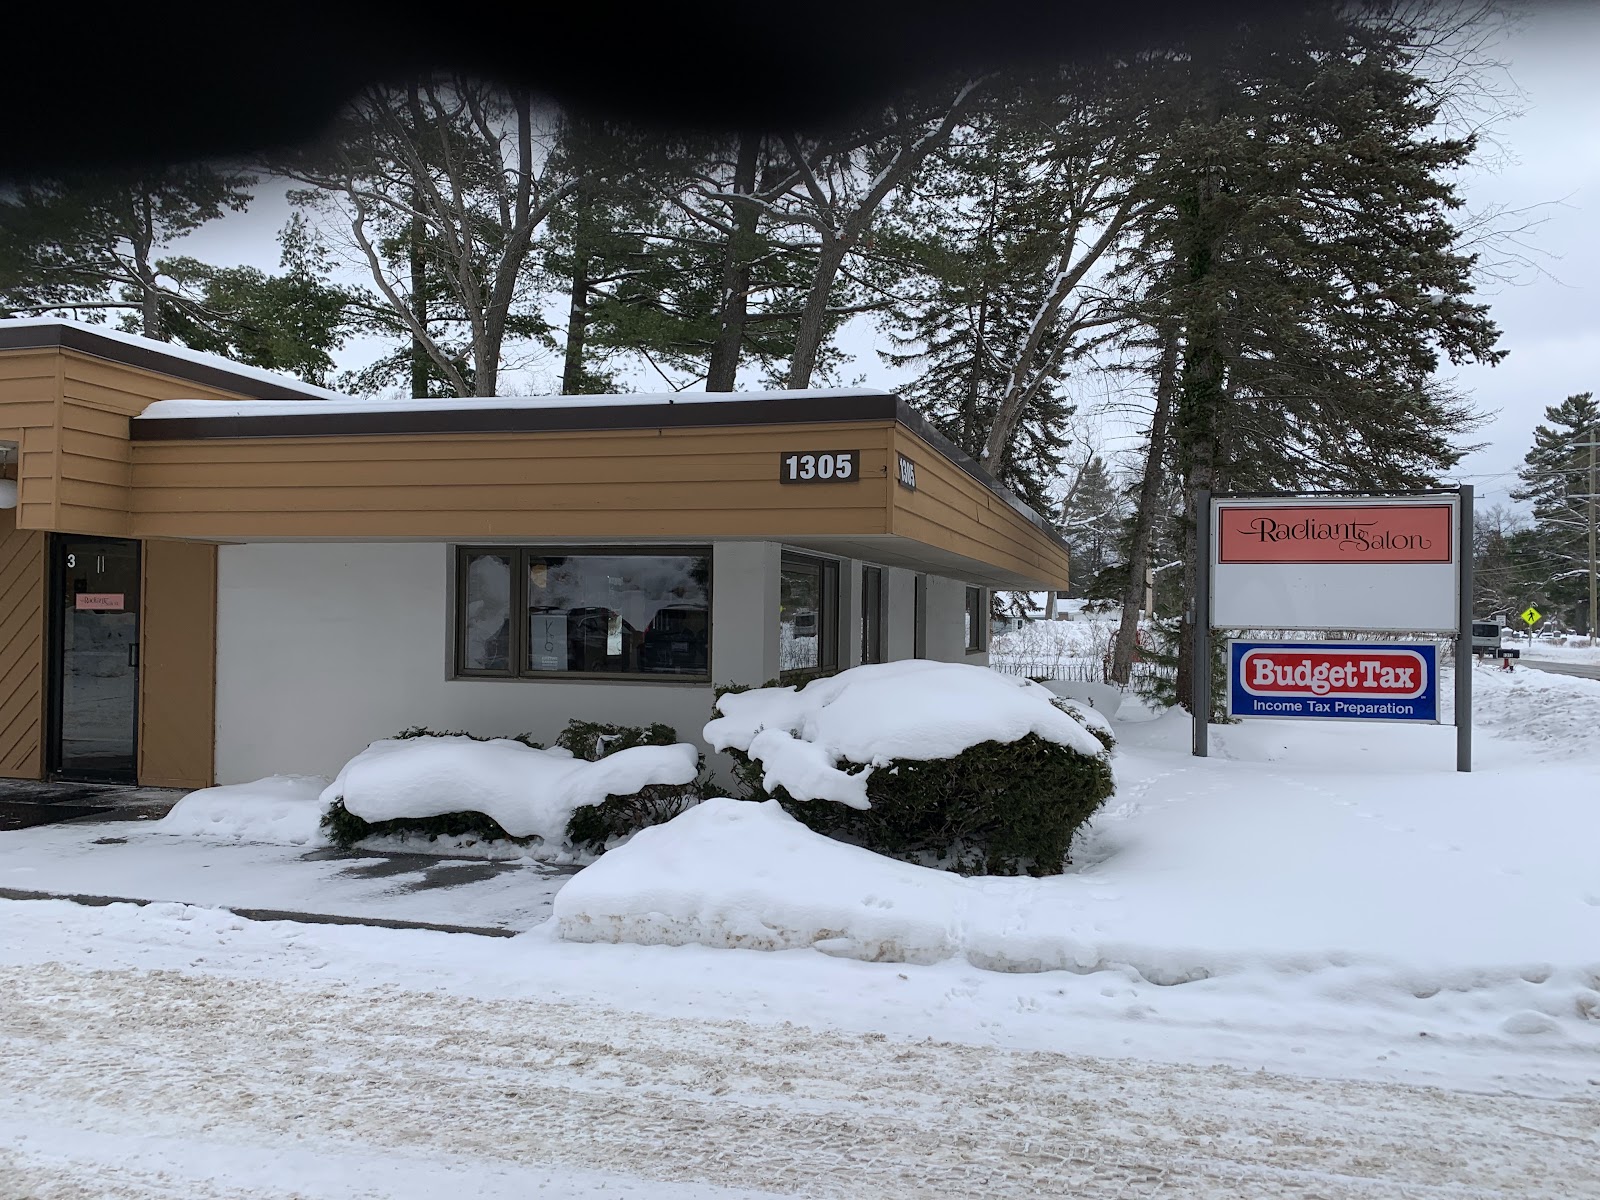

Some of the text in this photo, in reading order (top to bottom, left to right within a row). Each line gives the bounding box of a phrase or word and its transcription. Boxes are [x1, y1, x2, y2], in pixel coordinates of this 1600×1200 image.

[786, 454, 852, 480] 1305
[899, 458, 915, 487] 1305
[1236, 517, 1432, 551] Radiant Salon
[67, 553, 76, 568] 3
[1252, 658, 1414, 693] Budget Tax
[1253, 699, 1414, 715] Income Tax Preparation
